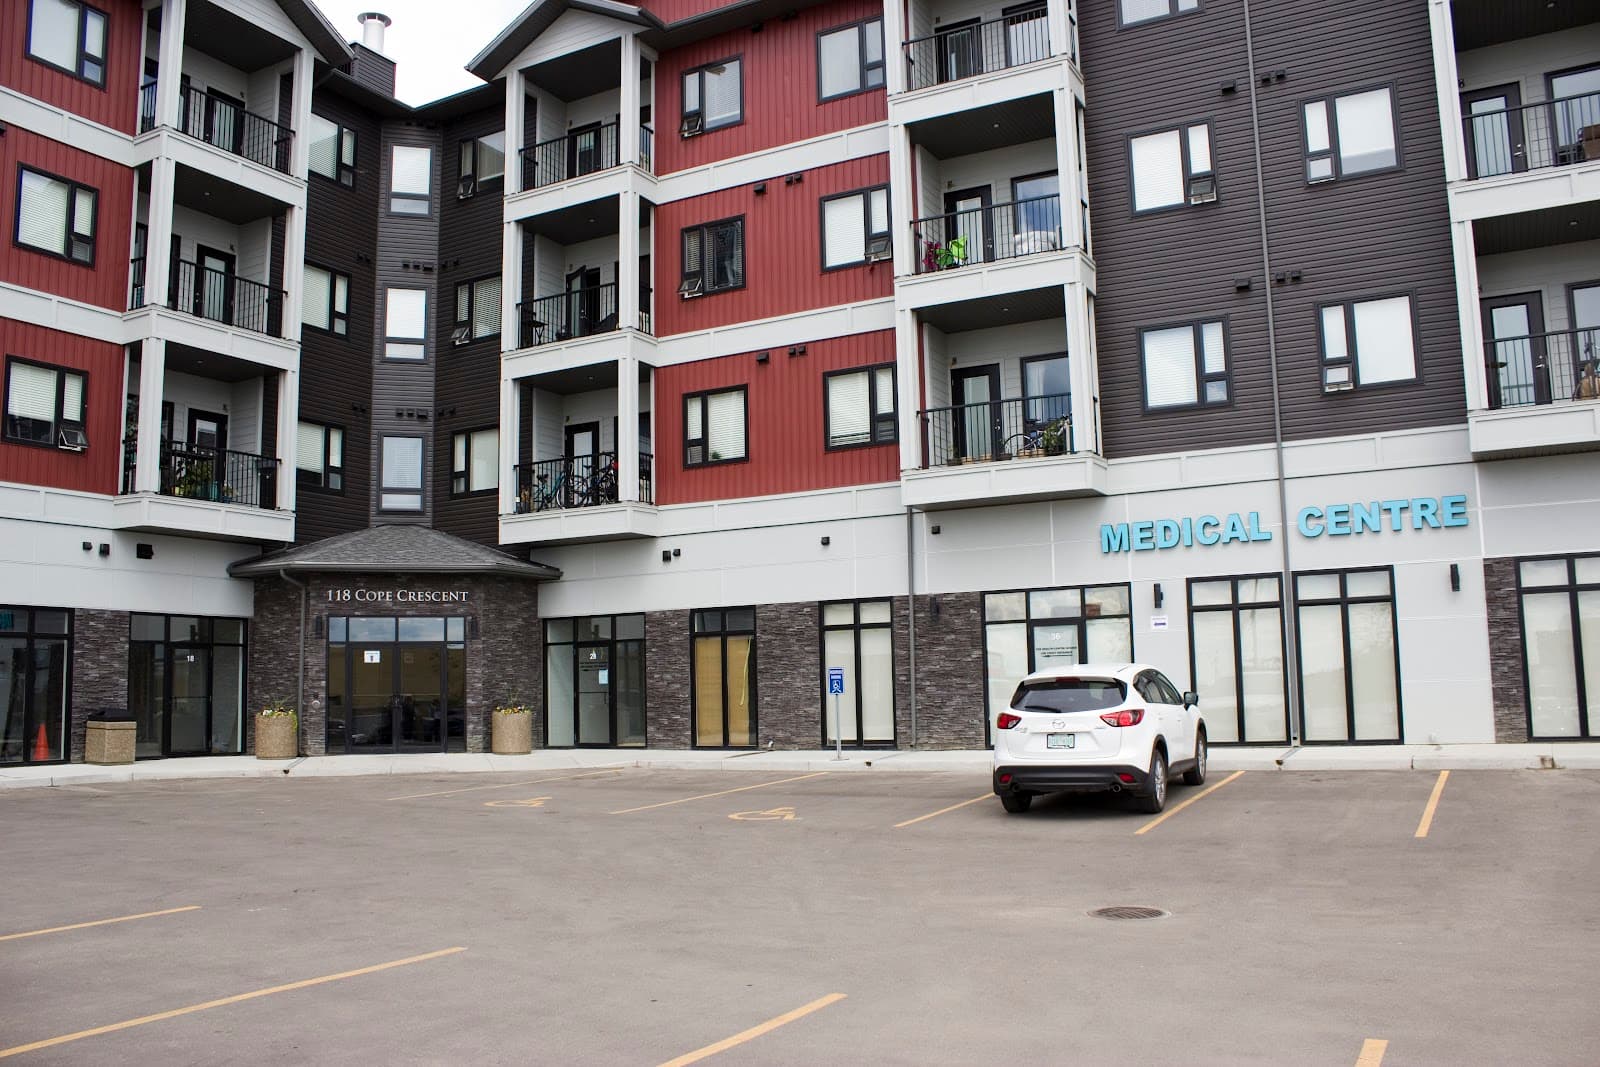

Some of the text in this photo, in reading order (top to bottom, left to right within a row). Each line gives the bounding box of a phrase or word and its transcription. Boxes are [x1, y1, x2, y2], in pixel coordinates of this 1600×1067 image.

[1101, 494, 1469, 554] MEDICAL CENTRE
[327, 589, 351, 602] 118
